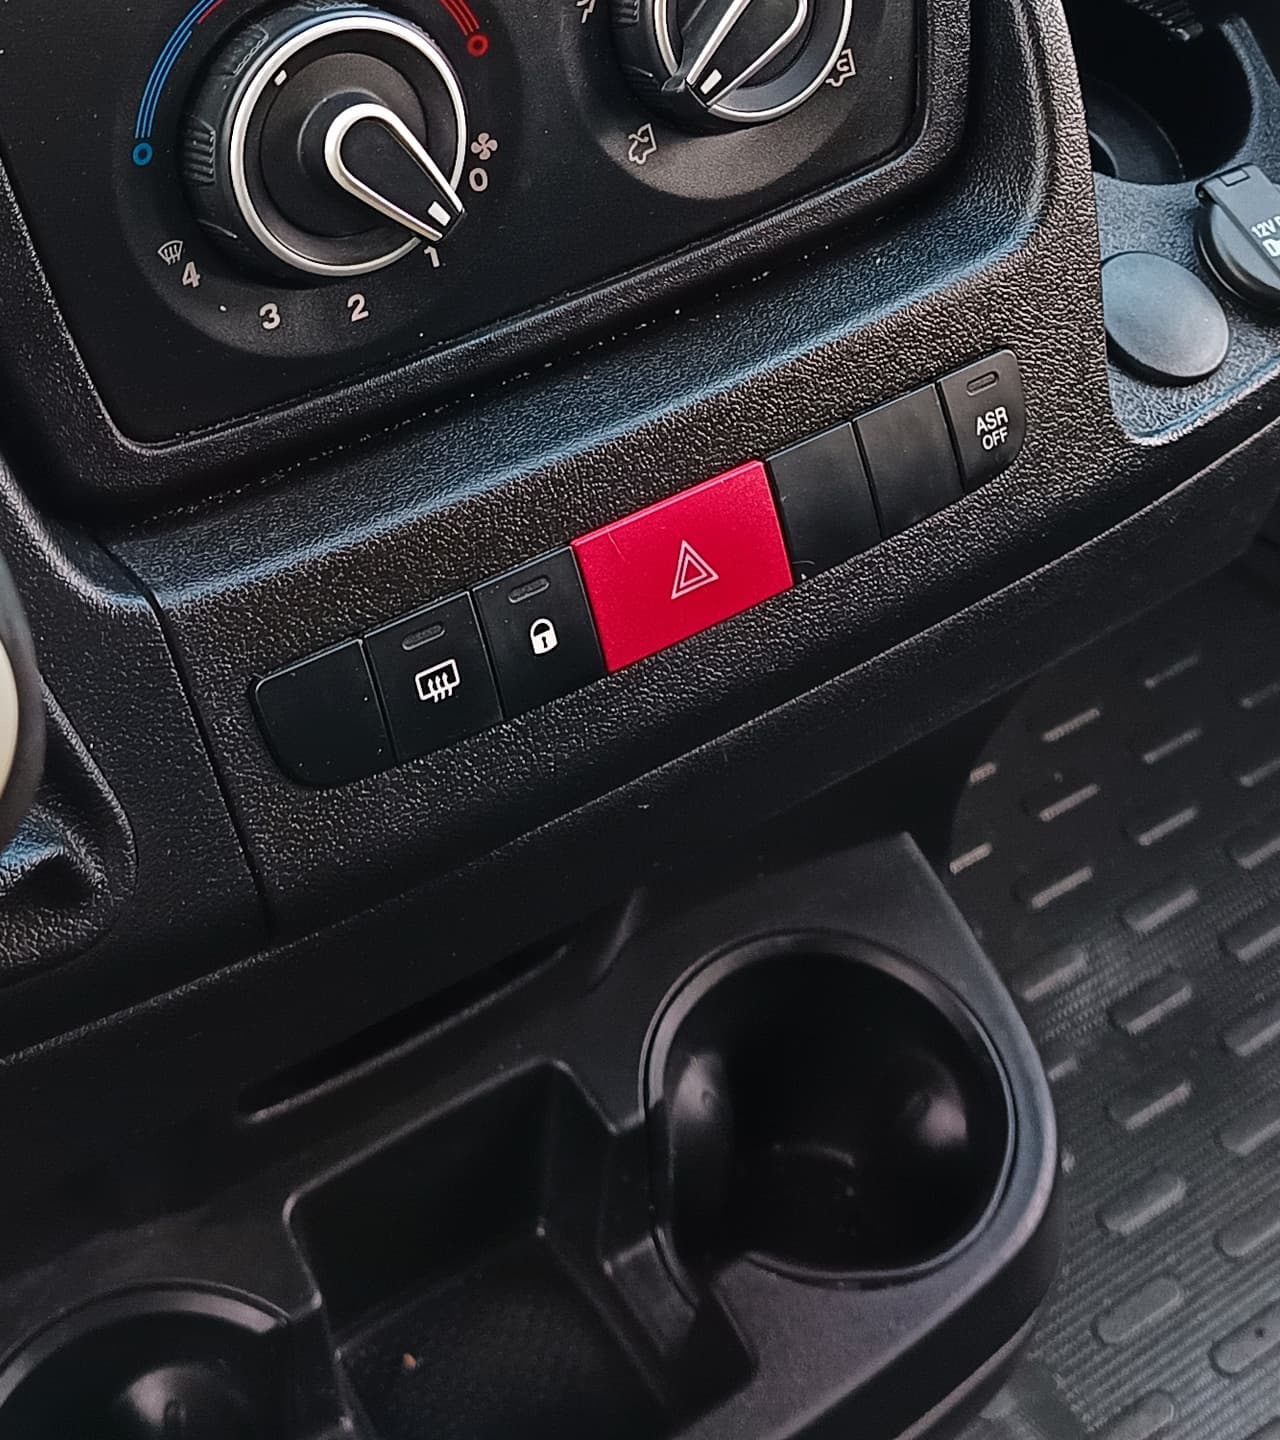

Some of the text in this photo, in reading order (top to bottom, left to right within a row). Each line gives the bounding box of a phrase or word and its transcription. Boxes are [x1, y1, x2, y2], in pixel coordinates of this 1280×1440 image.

[468, 167, 488, 192] 0
[1251, 218, 1275, 238] 12V
[424, 245, 441, 268] 1
[181, 261, 201, 288] 4
[259, 303, 281, 329] 3
[347, 293, 370, 322] 2
[976, 406, 1008, 436] ASR
[982, 426, 1008, 450] OFF
